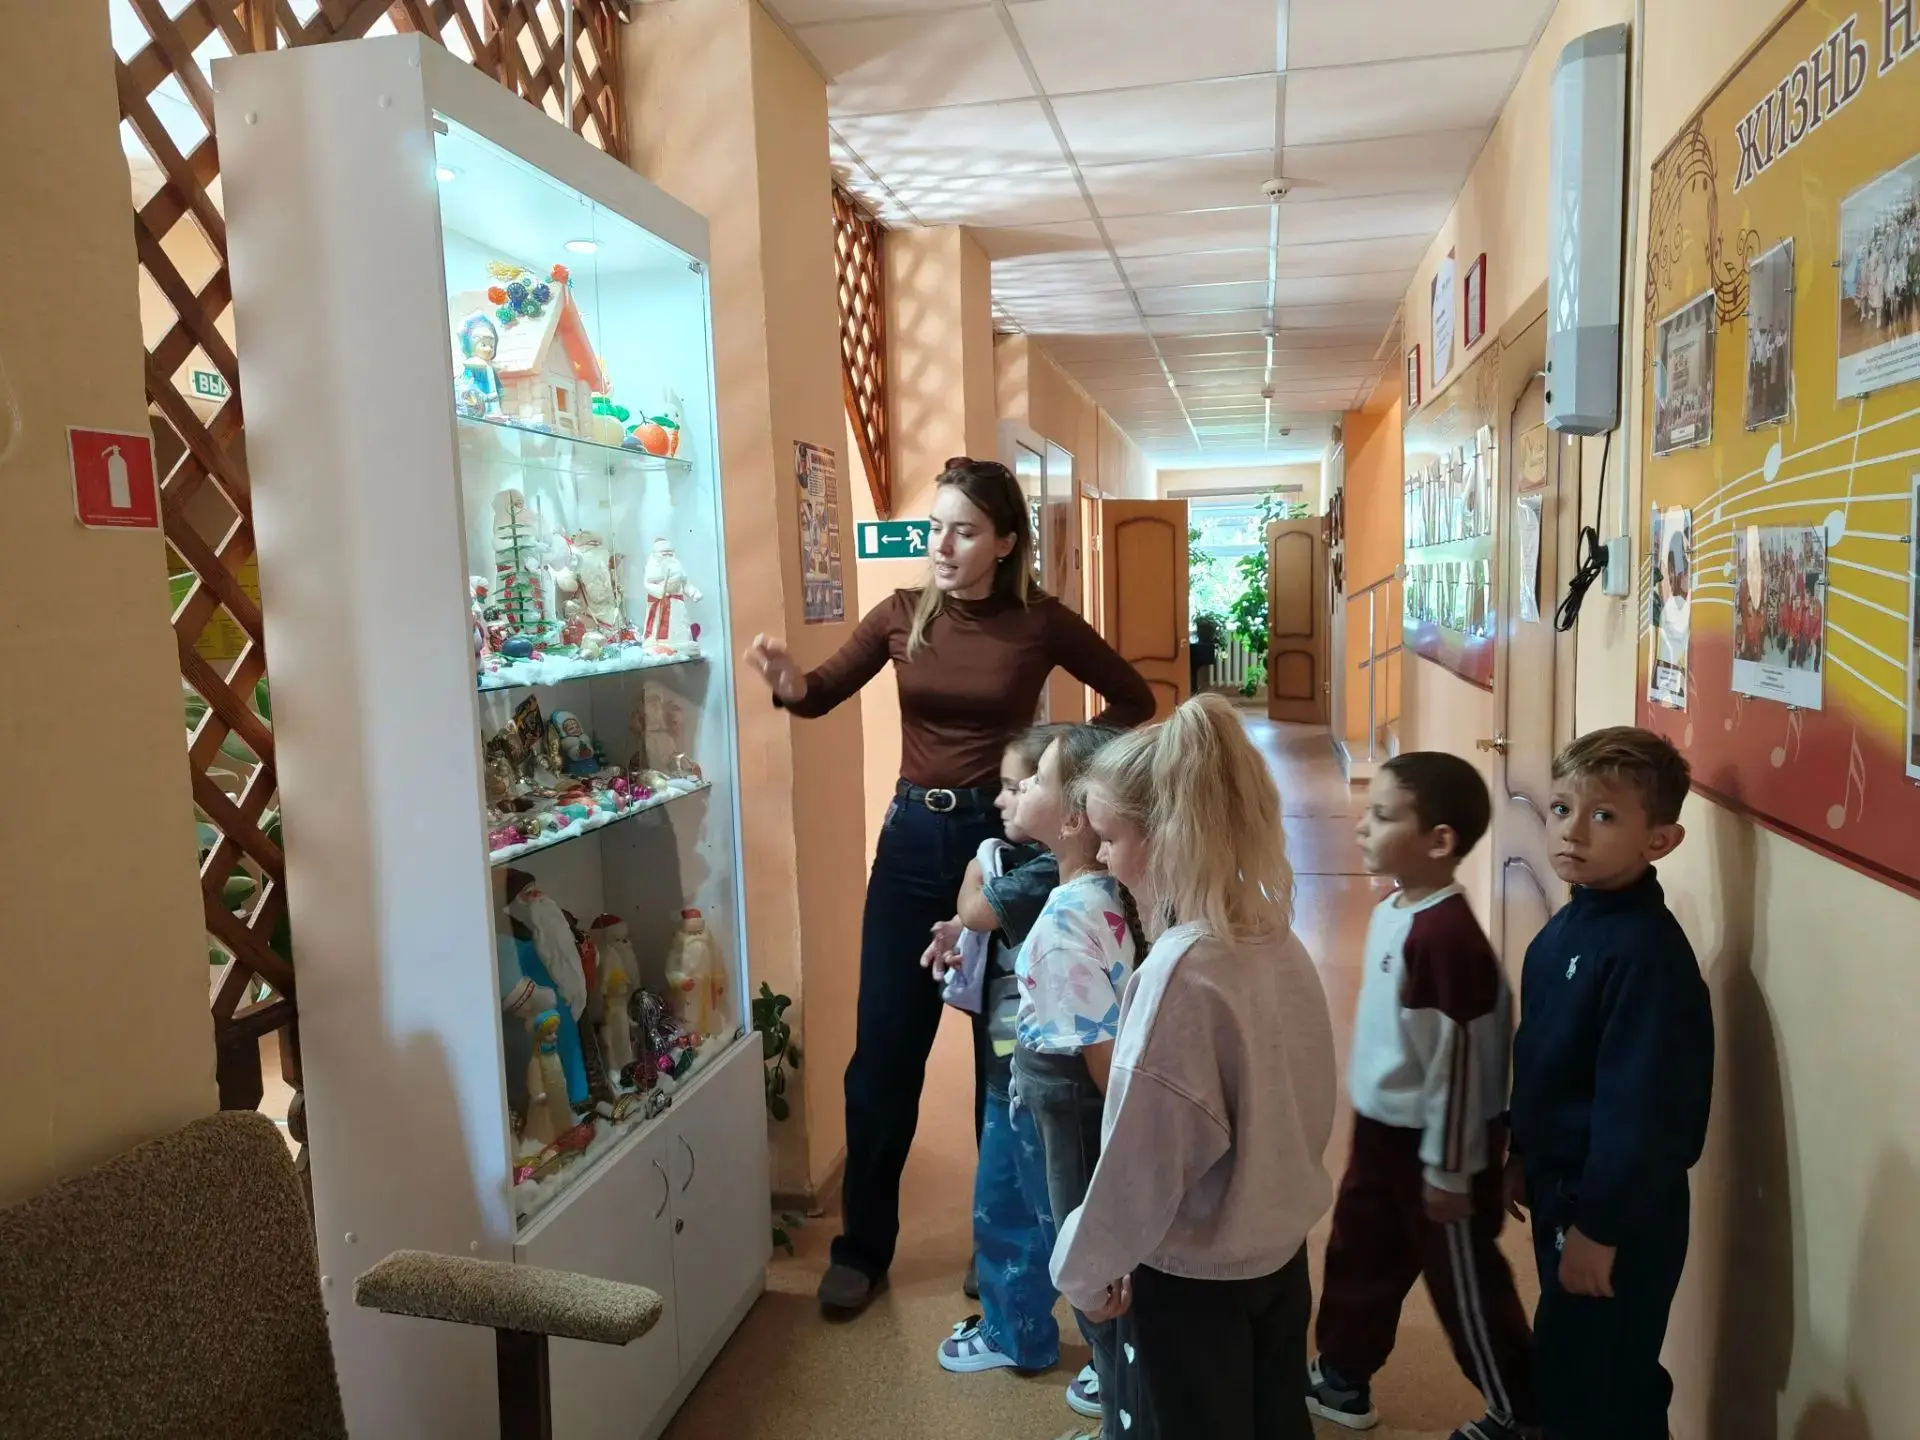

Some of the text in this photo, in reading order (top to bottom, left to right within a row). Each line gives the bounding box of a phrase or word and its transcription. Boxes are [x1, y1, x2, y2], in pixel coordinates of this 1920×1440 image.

[1733, 0, 1920, 193] ЖИЗНЬ Н
[199, 373, 227, 395] ВЫ
